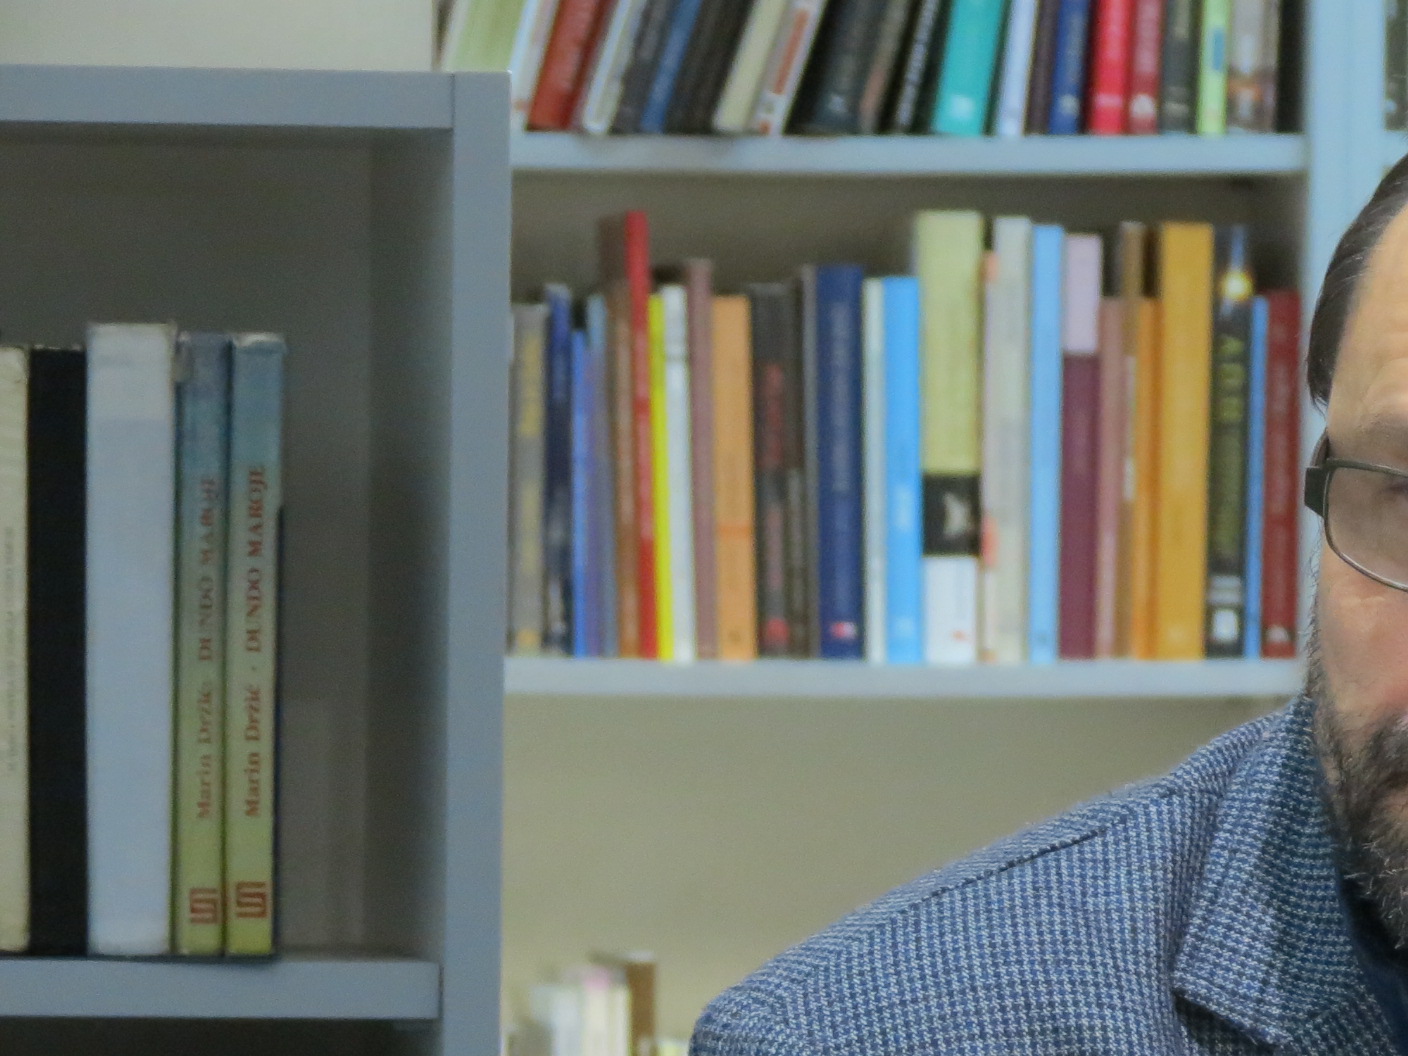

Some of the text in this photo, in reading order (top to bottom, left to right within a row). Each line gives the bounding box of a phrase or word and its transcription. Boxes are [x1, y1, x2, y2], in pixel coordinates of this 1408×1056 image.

[244, 465, 267, 817] Marin Držić DUNDO MAROJE
